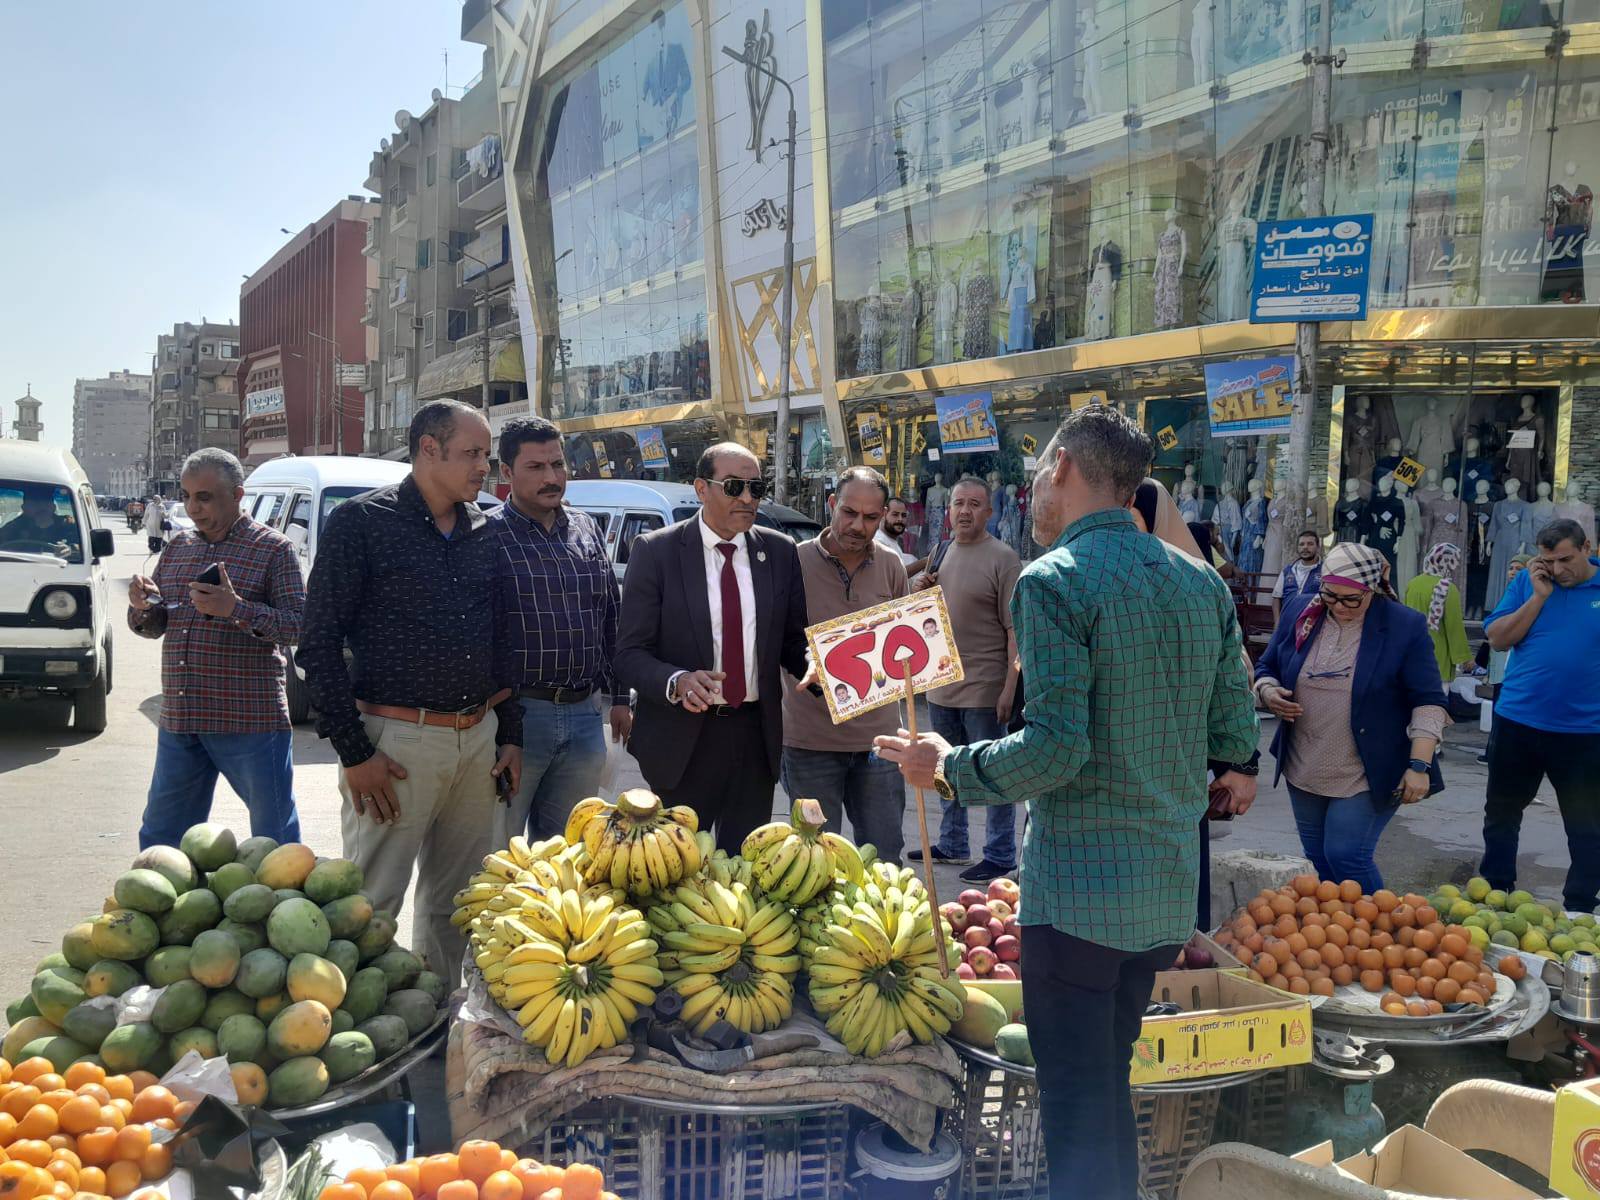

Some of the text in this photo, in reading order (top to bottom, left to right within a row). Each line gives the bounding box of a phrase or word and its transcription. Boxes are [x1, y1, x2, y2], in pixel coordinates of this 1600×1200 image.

[1260, 234, 1370, 262] فحوصات
[1212, 380, 1292, 423] SALE
[941, 410, 990, 442] SALE
[1159, 430, 1176, 447] 50%
[1396, 461, 1418, 483] 50%
